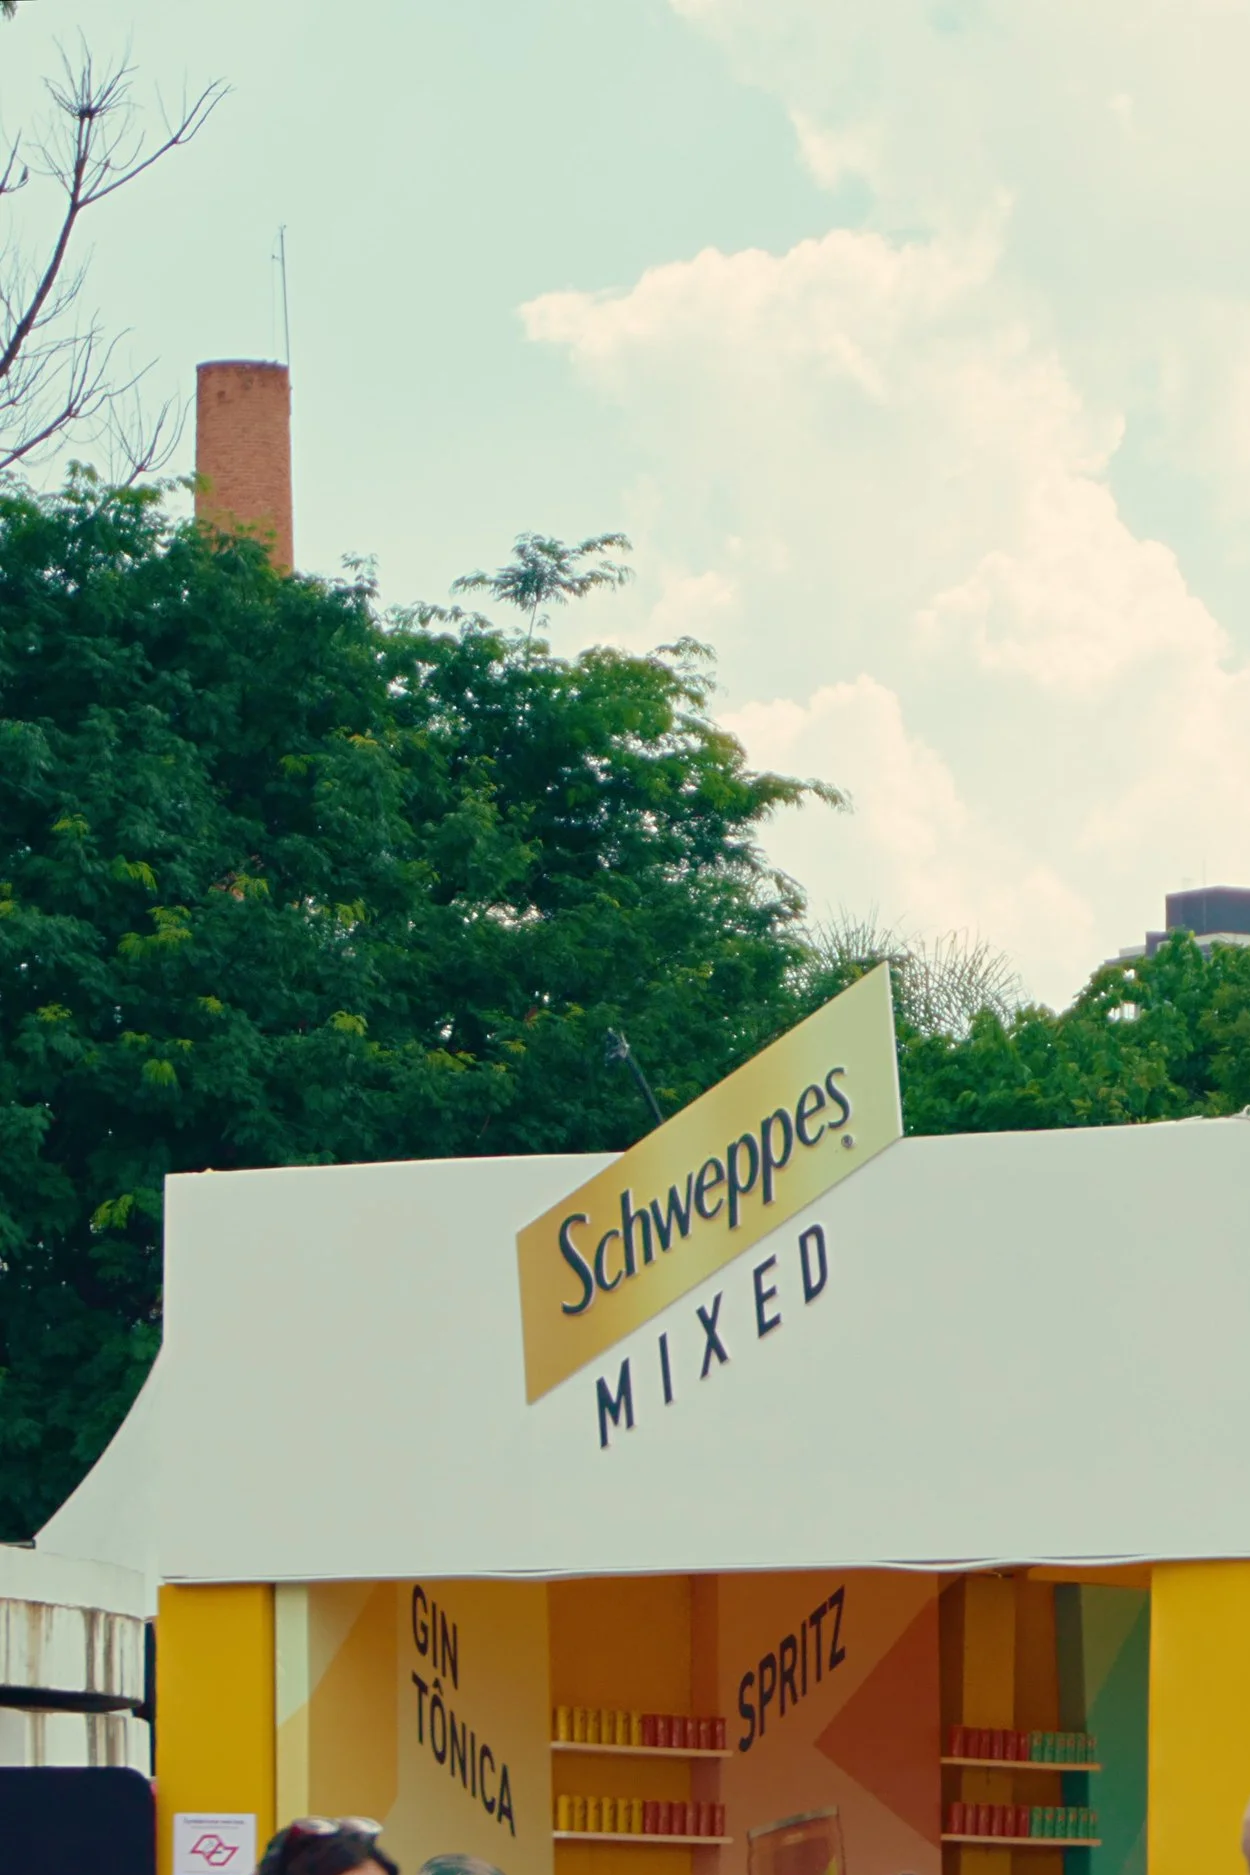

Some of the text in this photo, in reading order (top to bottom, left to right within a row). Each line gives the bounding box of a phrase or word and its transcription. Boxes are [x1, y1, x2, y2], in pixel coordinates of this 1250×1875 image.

[558, 1066, 852, 1315] Schweppes
[596, 1223, 829, 1450] MIXED
[411, 1583, 459, 1691] GIN
[738, 1583, 846, 1753] SPRITZ
[411, 1669, 516, 1838] TÔNICA
